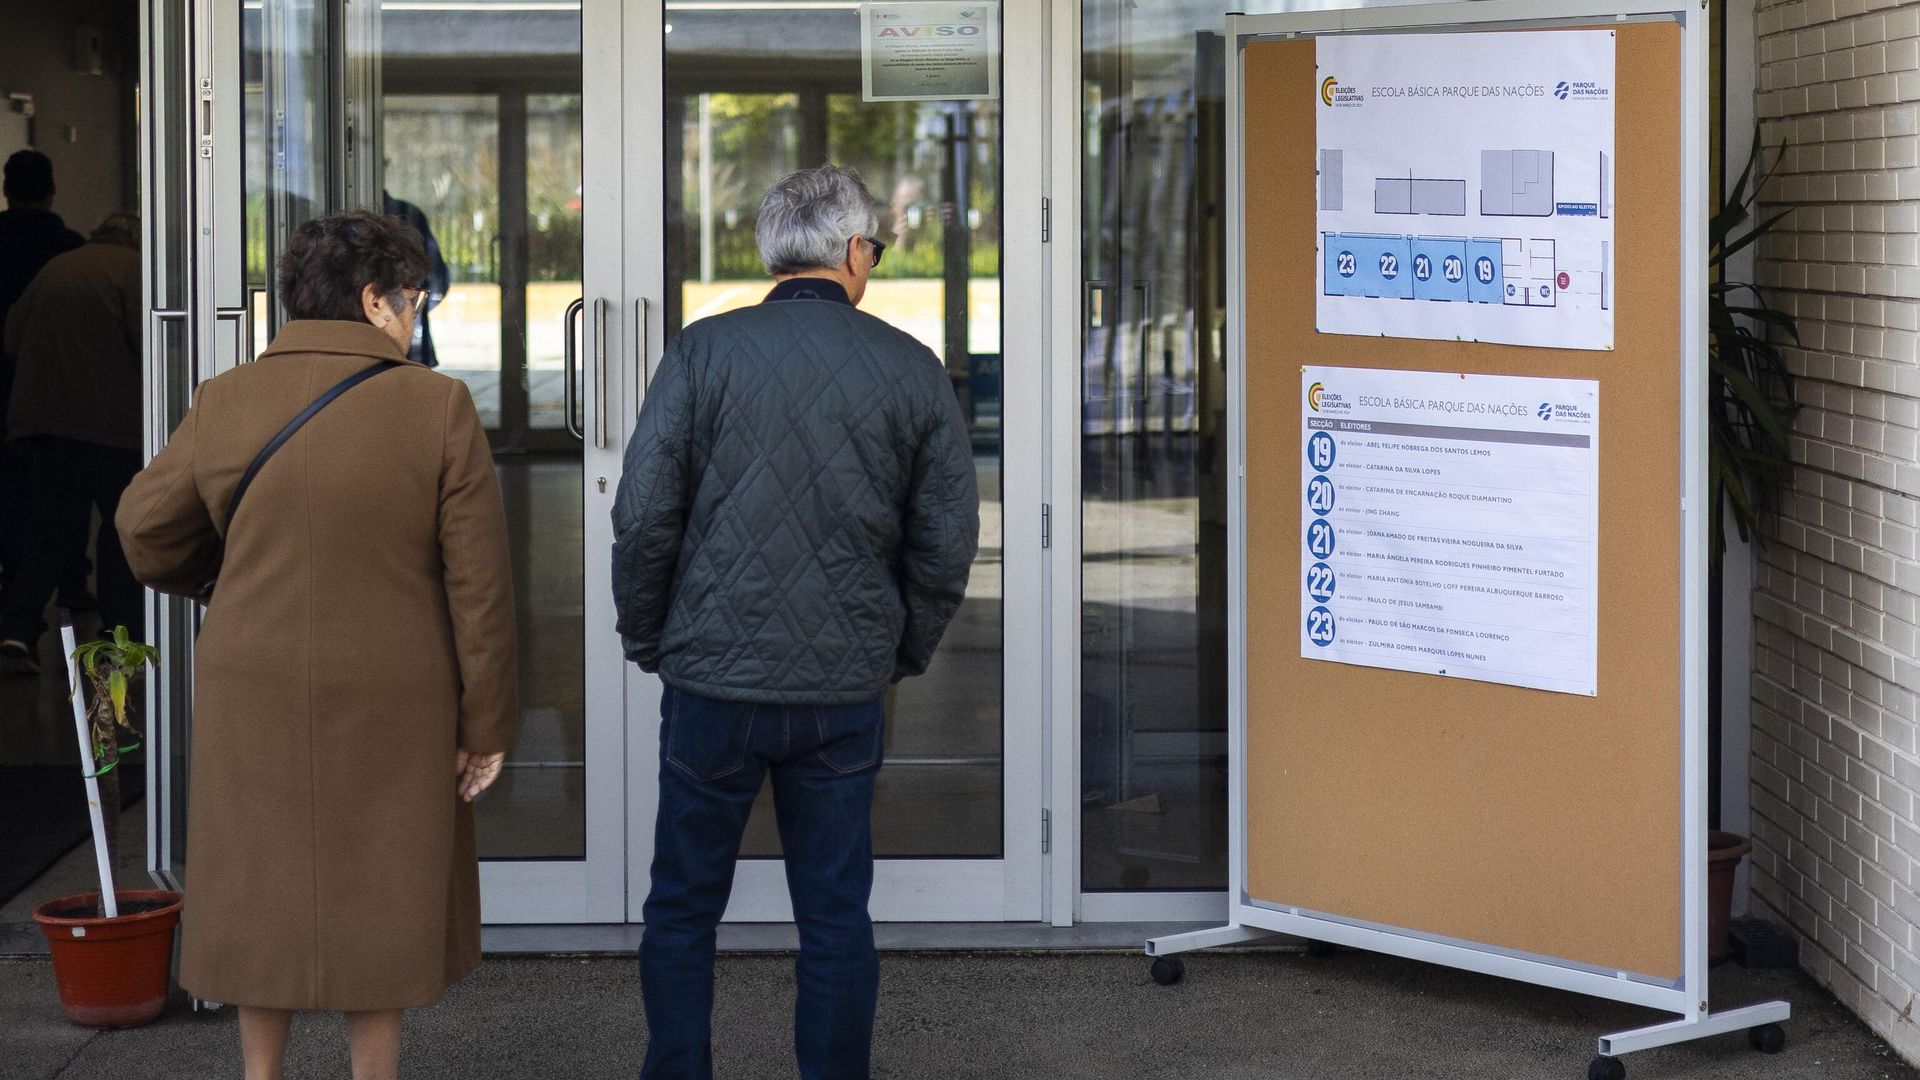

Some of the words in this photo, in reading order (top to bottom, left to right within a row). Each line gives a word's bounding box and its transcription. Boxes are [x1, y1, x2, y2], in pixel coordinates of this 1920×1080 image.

[878, 26, 980, 37] AVISO
[1335, 86, 1356, 94] ELEIÇÕES
[1372, 86, 1406, 97] ESCOLA
[1408, 84, 1440, 97] BÁSICA
[1442, 86, 1479, 98] PARQUE
[1482, 86, 1500, 97] DAS
[1503, 84, 1545, 98] NAÇÕES
[1585, 87, 1609, 95] NAÇÕES
[1339, 254, 1355, 274] 23
[1381, 255, 1397, 276] 22
[1416, 257, 1430, 278] 21
[1445, 258, 1461, 279] 20
[1479, 260, 1492, 280] 19
[1321, 393, 1342, 401] ELEIÇÕES
[1321, 401, 1352, 410] LEGISLATIVAS
[1360, 396, 1391, 408] ESCOLA
[1393, 397, 1425, 410] BÁSICA
[1428, 400, 1464, 413] PARQUE
[1467, 402, 1485, 413] DAS
[1487, 403, 1528, 416] NAÇÕES
[1567, 410, 1591, 419] NAÇÕES
[1310, 420, 1334, 429] SECÇÃO
[1340, 422, 1372, 431] ELEITORES
[1312, 437, 1331, 467] 19
[1367, 441, 1380, 449] ABEL
[1382, 442, 1400, 450] FELIPE
[1444, 447, 1468, 455] SANTOS
[1366, 464, 1394, 472] CATARINA
[1404, 466, 1420, 474] SILVA
[1422, 468, 1441, 476] LOPES
[1310, 480, 1332, 511] 20
[1366, 486, 1394, 494] CATARINA
[1405, 489, 1447, 499] ENCARNAÇÃO
[1449, 492, 1470, 501] ROQUE
[1472, 495, 1513, 504] DIAMANTINO
[1379, 509, 1400, 517] ZHANG
[1312, 524, 1331, 554] 21
[1366, 530, 1385, 538] JOANA
[1386, 532, 1406, 540] AMADO
[1417, 535, 1441, 544] FREITAS
[1441, 537, 1461, 545] VIEIRA
[1462, 540, 1494, 548] NOGUEIRA
[1366, 552, 1385, 560] MARIA
[1410, 556, 1434, 565] PEREIRA
[1435, 560, 1470, 569] RODRIGUES
[1471, 563, 1501, 572] PINHEIRO
[1503, 566, 1534, 575] PIMENTEL
[1534, 569, 1564, 578] FURTADO
[1310, 566, 1333, 597] 22
[1415, 579, 1442, 589] BOTELHO
[1460, 584, 1485, 593] PEREIRA
[1486, 587, 1533, 598] ALBUQUERQUE
[1534, 592, 1564, 601] BARROSO
[1367, 596, 1387, 604] PAULO
[1310, 611, 1333, 642] 23
[1368, 619, 1389, 627] PAULO
[1399, 620, 1411, 629] SÃO
[1412, 624, 1436, 632] MARCOS
[1446, 628, 1474, 637] FONSECA
[1368, 640, 1395, 649] ZULMIRA
[1396, 644, 1417, 652] GOMES
[1418, 646, 1446, 655] MARQUES
[1446, 650, 1465, 659] LOPES
[1465, 653, 1487, 662] NUNES
